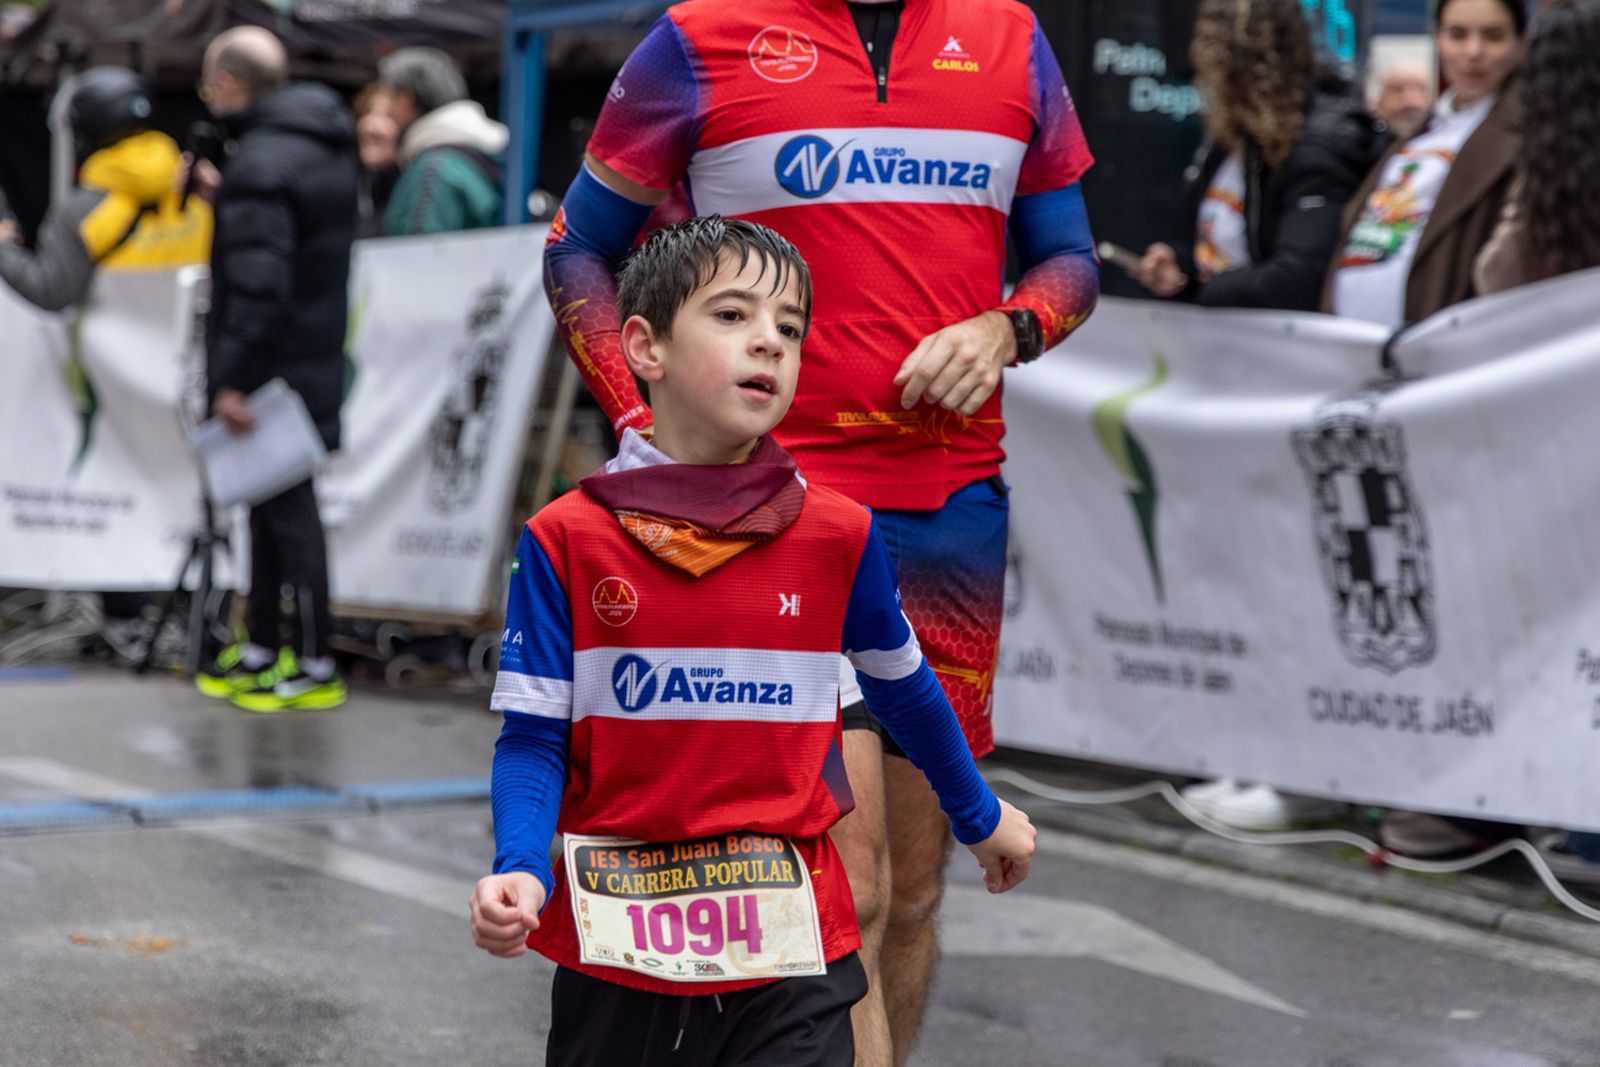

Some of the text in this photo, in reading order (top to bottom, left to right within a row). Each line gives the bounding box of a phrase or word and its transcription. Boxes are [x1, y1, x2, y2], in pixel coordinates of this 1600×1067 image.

[932, 58, 980, 72] CARLOS
[845, 149, 991, 190] Avanza
[873, 147, 906, 157] GRUPO
[660, 667, 793, 705] Avanza
[690, 667, 723, 678] GRUPO
[589, 835, 785, 869] IES San Juan Bosco
[585, 859, 795, 895] V CARRERA POPULAR
[626, 894, 763, 957] 1094
